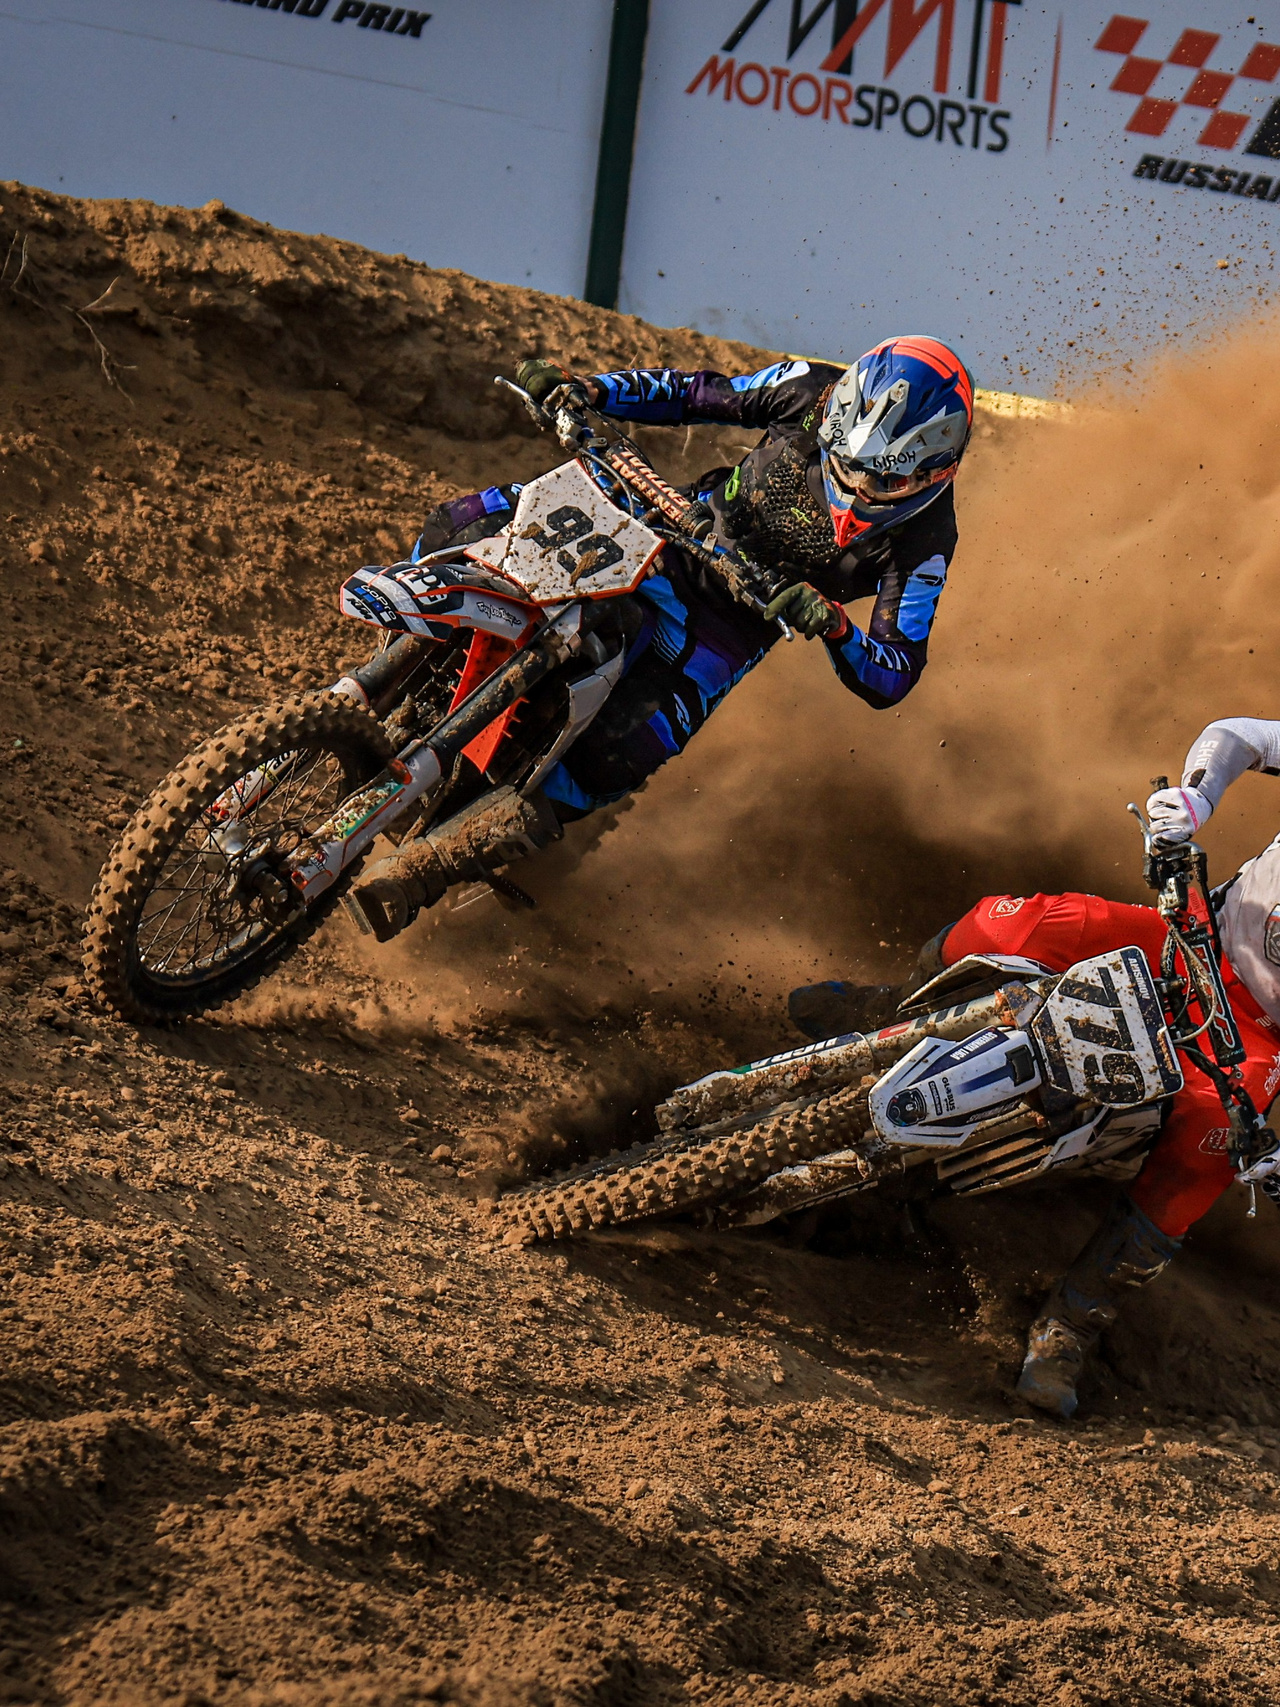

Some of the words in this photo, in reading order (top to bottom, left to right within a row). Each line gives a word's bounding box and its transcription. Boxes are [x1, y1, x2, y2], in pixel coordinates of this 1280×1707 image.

[331, 0, 432, 38] PRIX
[684, 54, 1011, 153] MOTORSPORTS
[611, 453, 685, 522] ENTHAL
[621, 446, 692, 511] ENTHAL
[346, 597, 373, 620] KTM
[359, 584, 397, 622] GoPro
[1128, 957, 1151, 1000] ANISIMOV
[950, 1049, 967, 1061] LIGA
[1058, 966, 1146, 1104] 779
